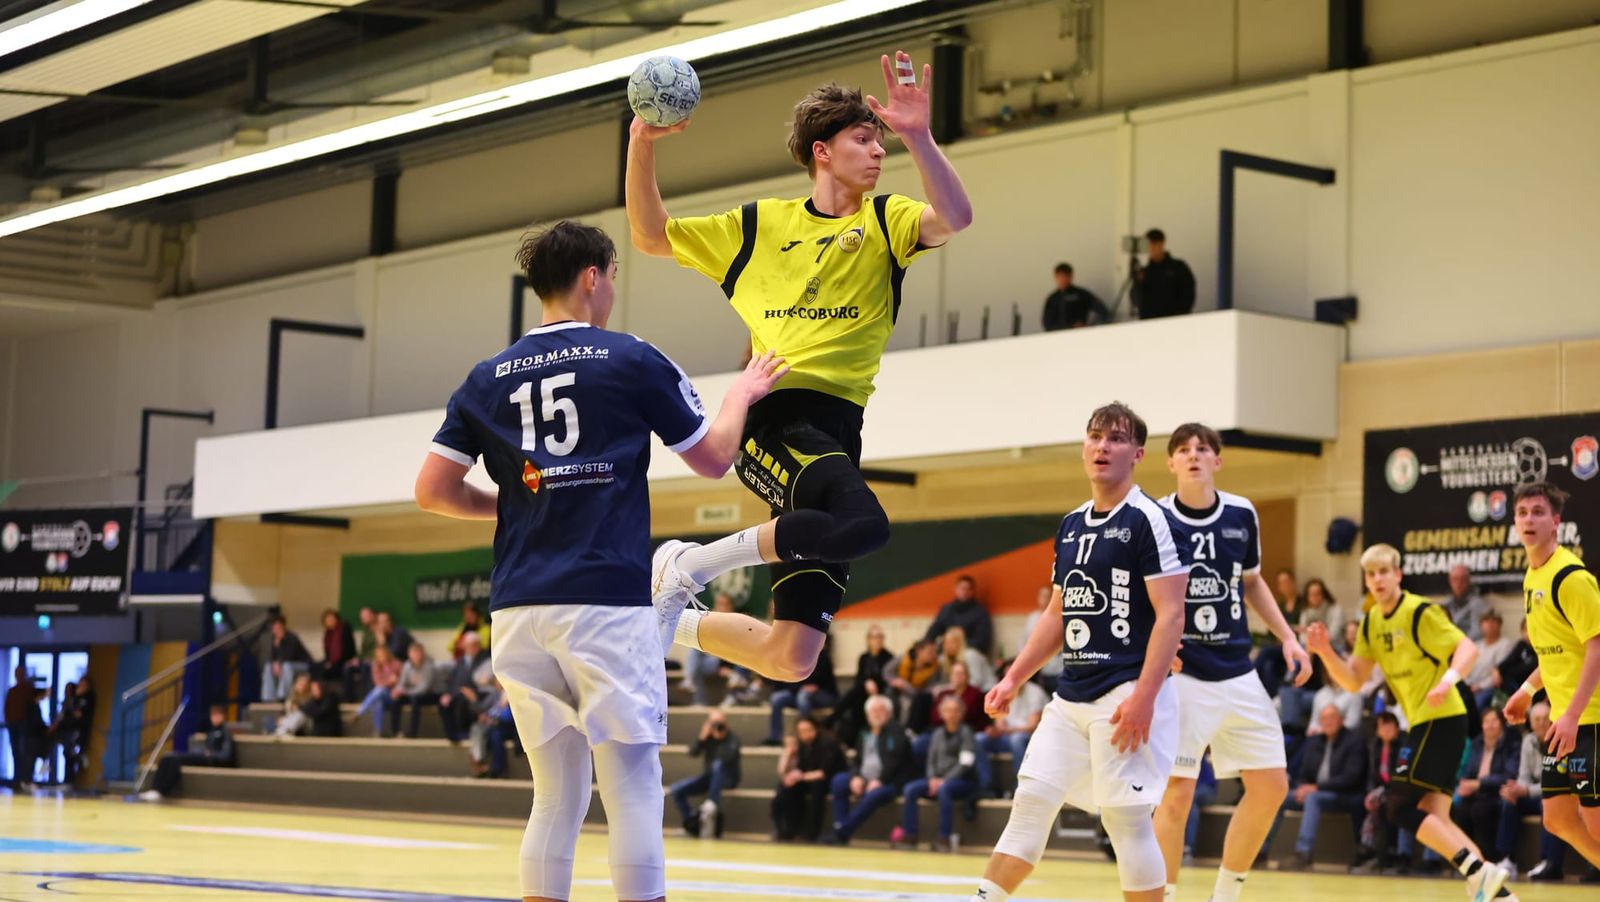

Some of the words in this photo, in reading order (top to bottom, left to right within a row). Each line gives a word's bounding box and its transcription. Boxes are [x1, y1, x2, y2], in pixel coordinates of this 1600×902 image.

[658, 92, 695, 111] SELECT
[816, 234, 835, 264] 7
[764, 305, 860, 320] HUK-COBURG
[512, 346, 594, 369] FORMAXX
[594, 348, 609, 356] AG
[509, 372, 580, 457] 15
[540, 462, 615, 479] MERZSYSTEM
[545, 476, 615, 490] erpackungsmaschinen
[1077, 533, 1098, 564] 17
[1190, 531, 1216, 560] 21
[1405, 527, 1506, 551] GEMEINSAM
[1403, 549, 1499, 575] ZUSAMMEN
[1064, 595, 1096, 608] WOLKE
[1066, 586, 1092, 598] PIZZA
[1110, 567, 1131, 639] BERO
